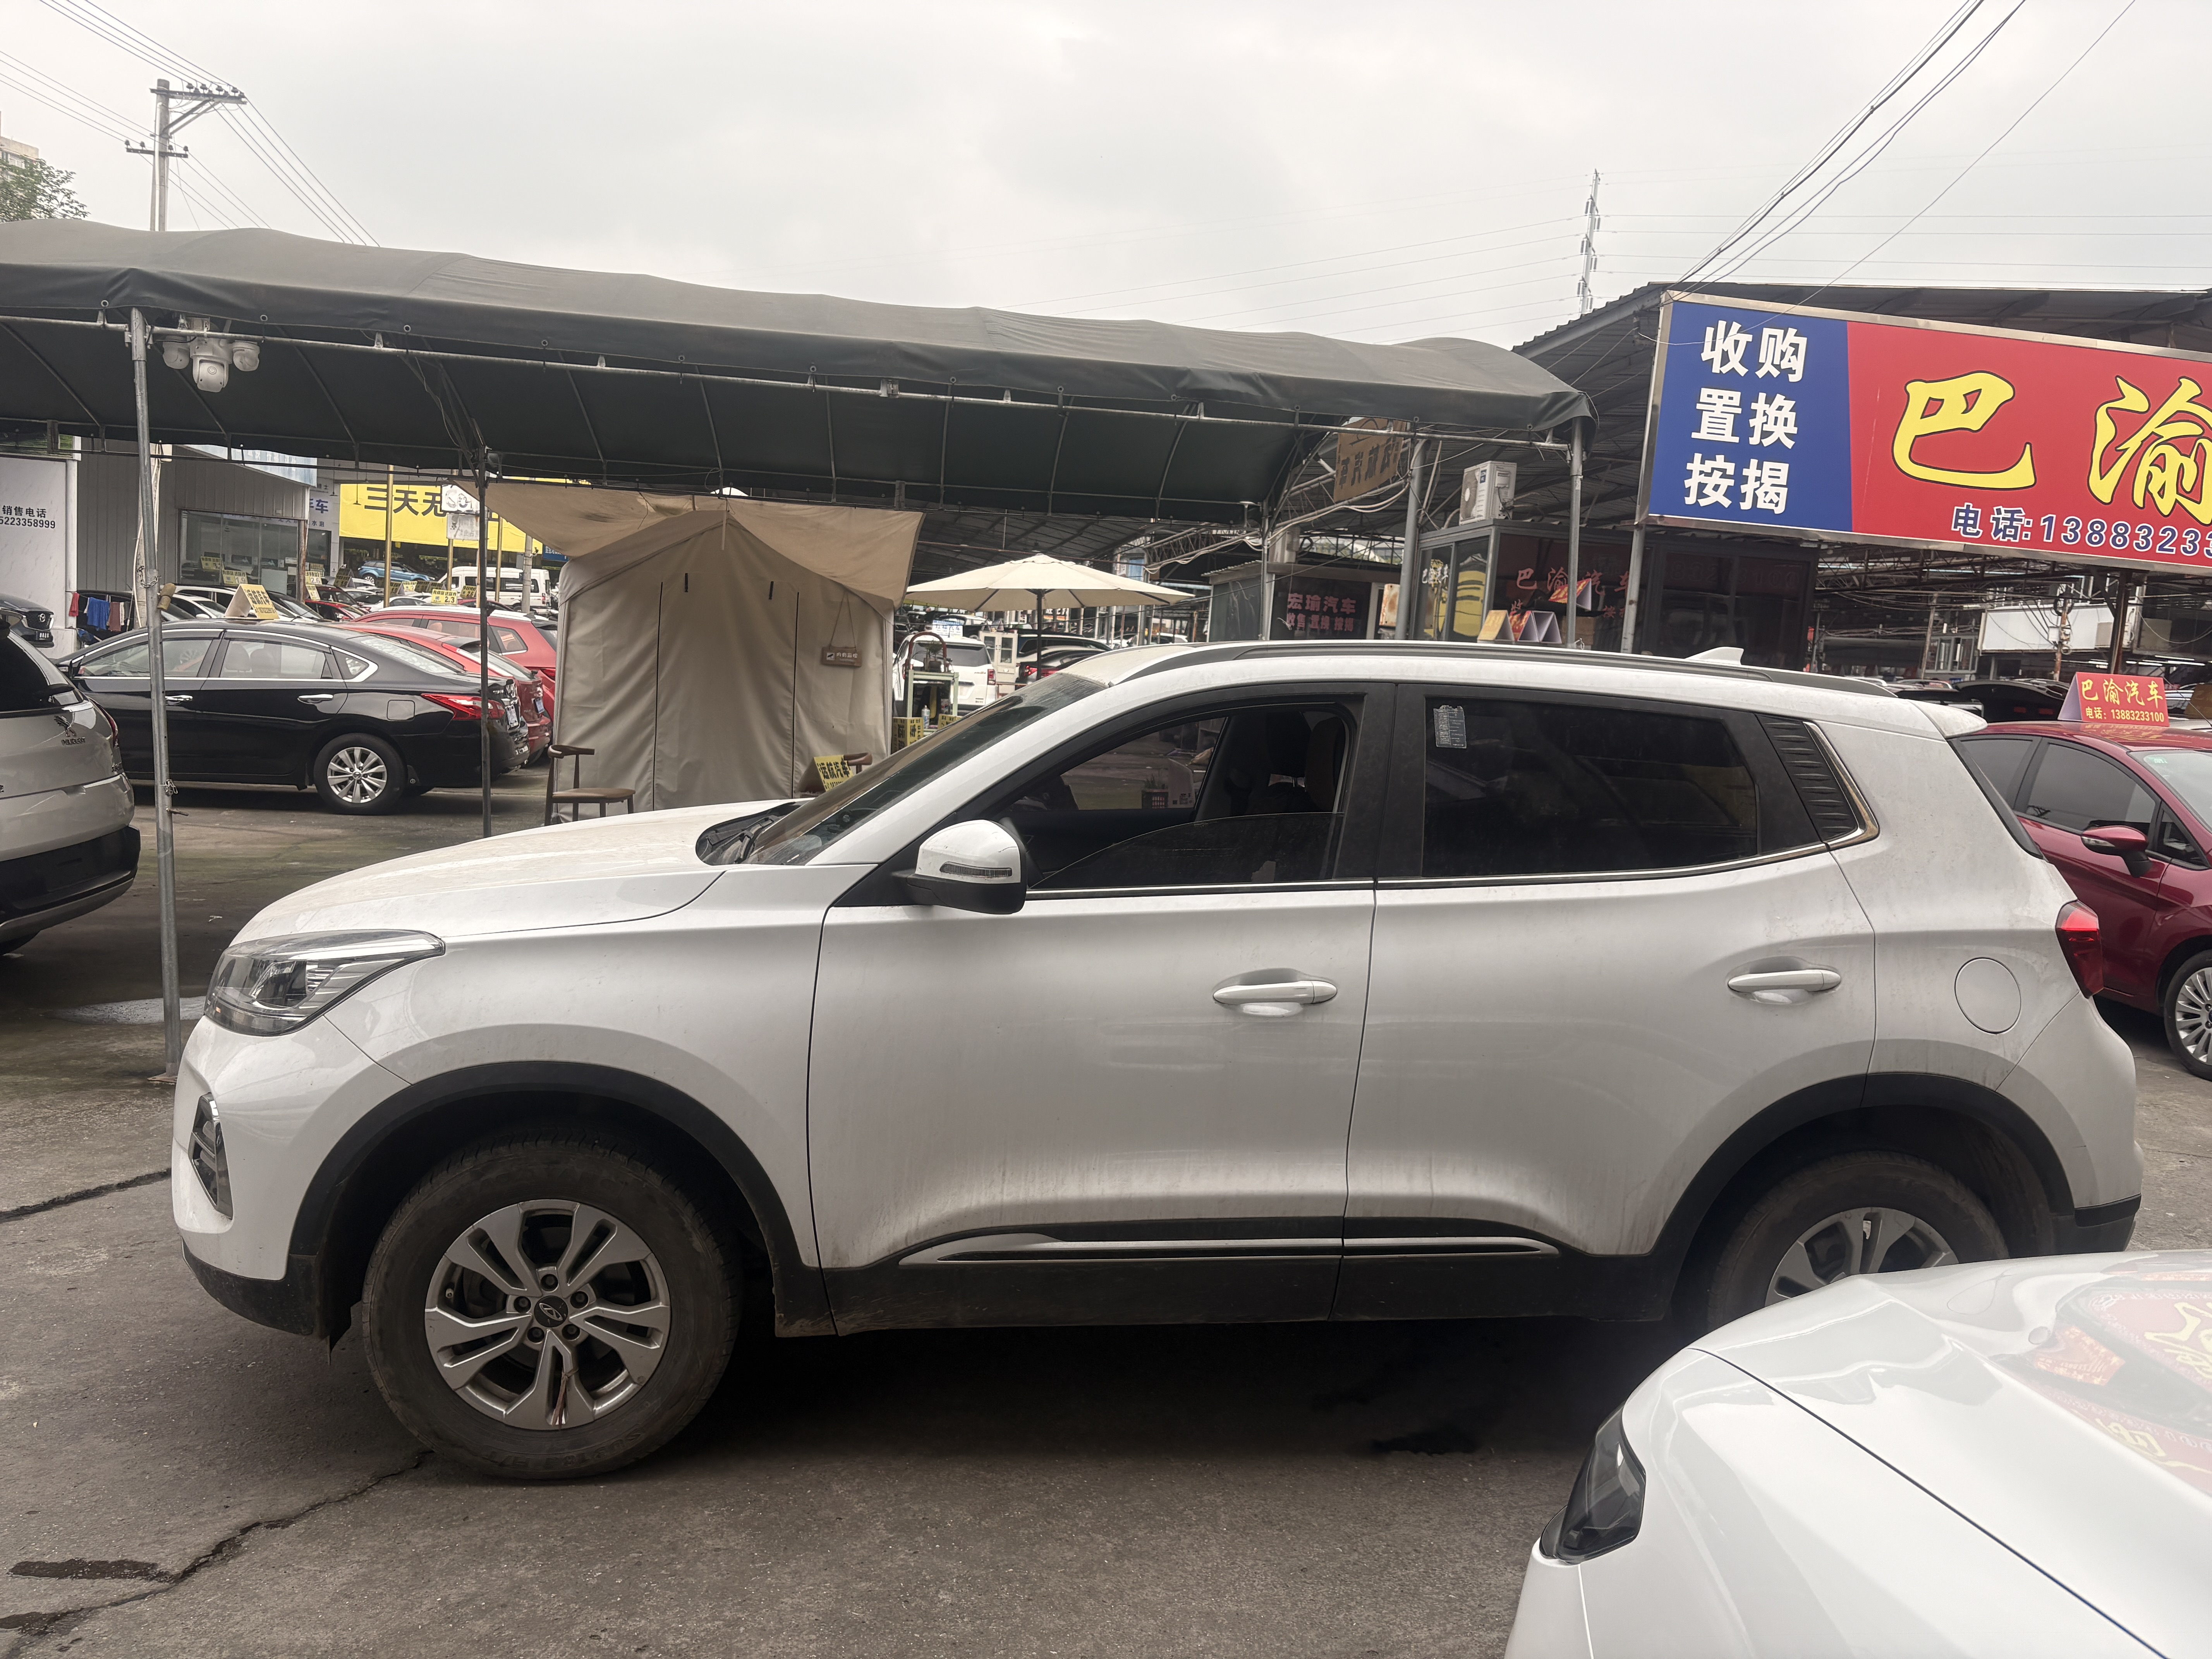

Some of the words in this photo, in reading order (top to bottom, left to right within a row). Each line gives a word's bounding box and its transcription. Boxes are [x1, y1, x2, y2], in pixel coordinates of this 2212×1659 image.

[1700, 320, 1808, 383] 收购
[1691, 388, 1798, 449] 置换
[1891, 370, 2212, 526] 巴渝
[1684, 453, 1790, 514] 按揭
[2, 505, 47, 518] 销售电话
[364, 487, 447, 517] 三天无
[0, 516, 56, 529] 5223358999
[1288, 593, 1356, 614] 宏瑜汽车
[2081, 678, 2164, 709] 巴渝汽车
